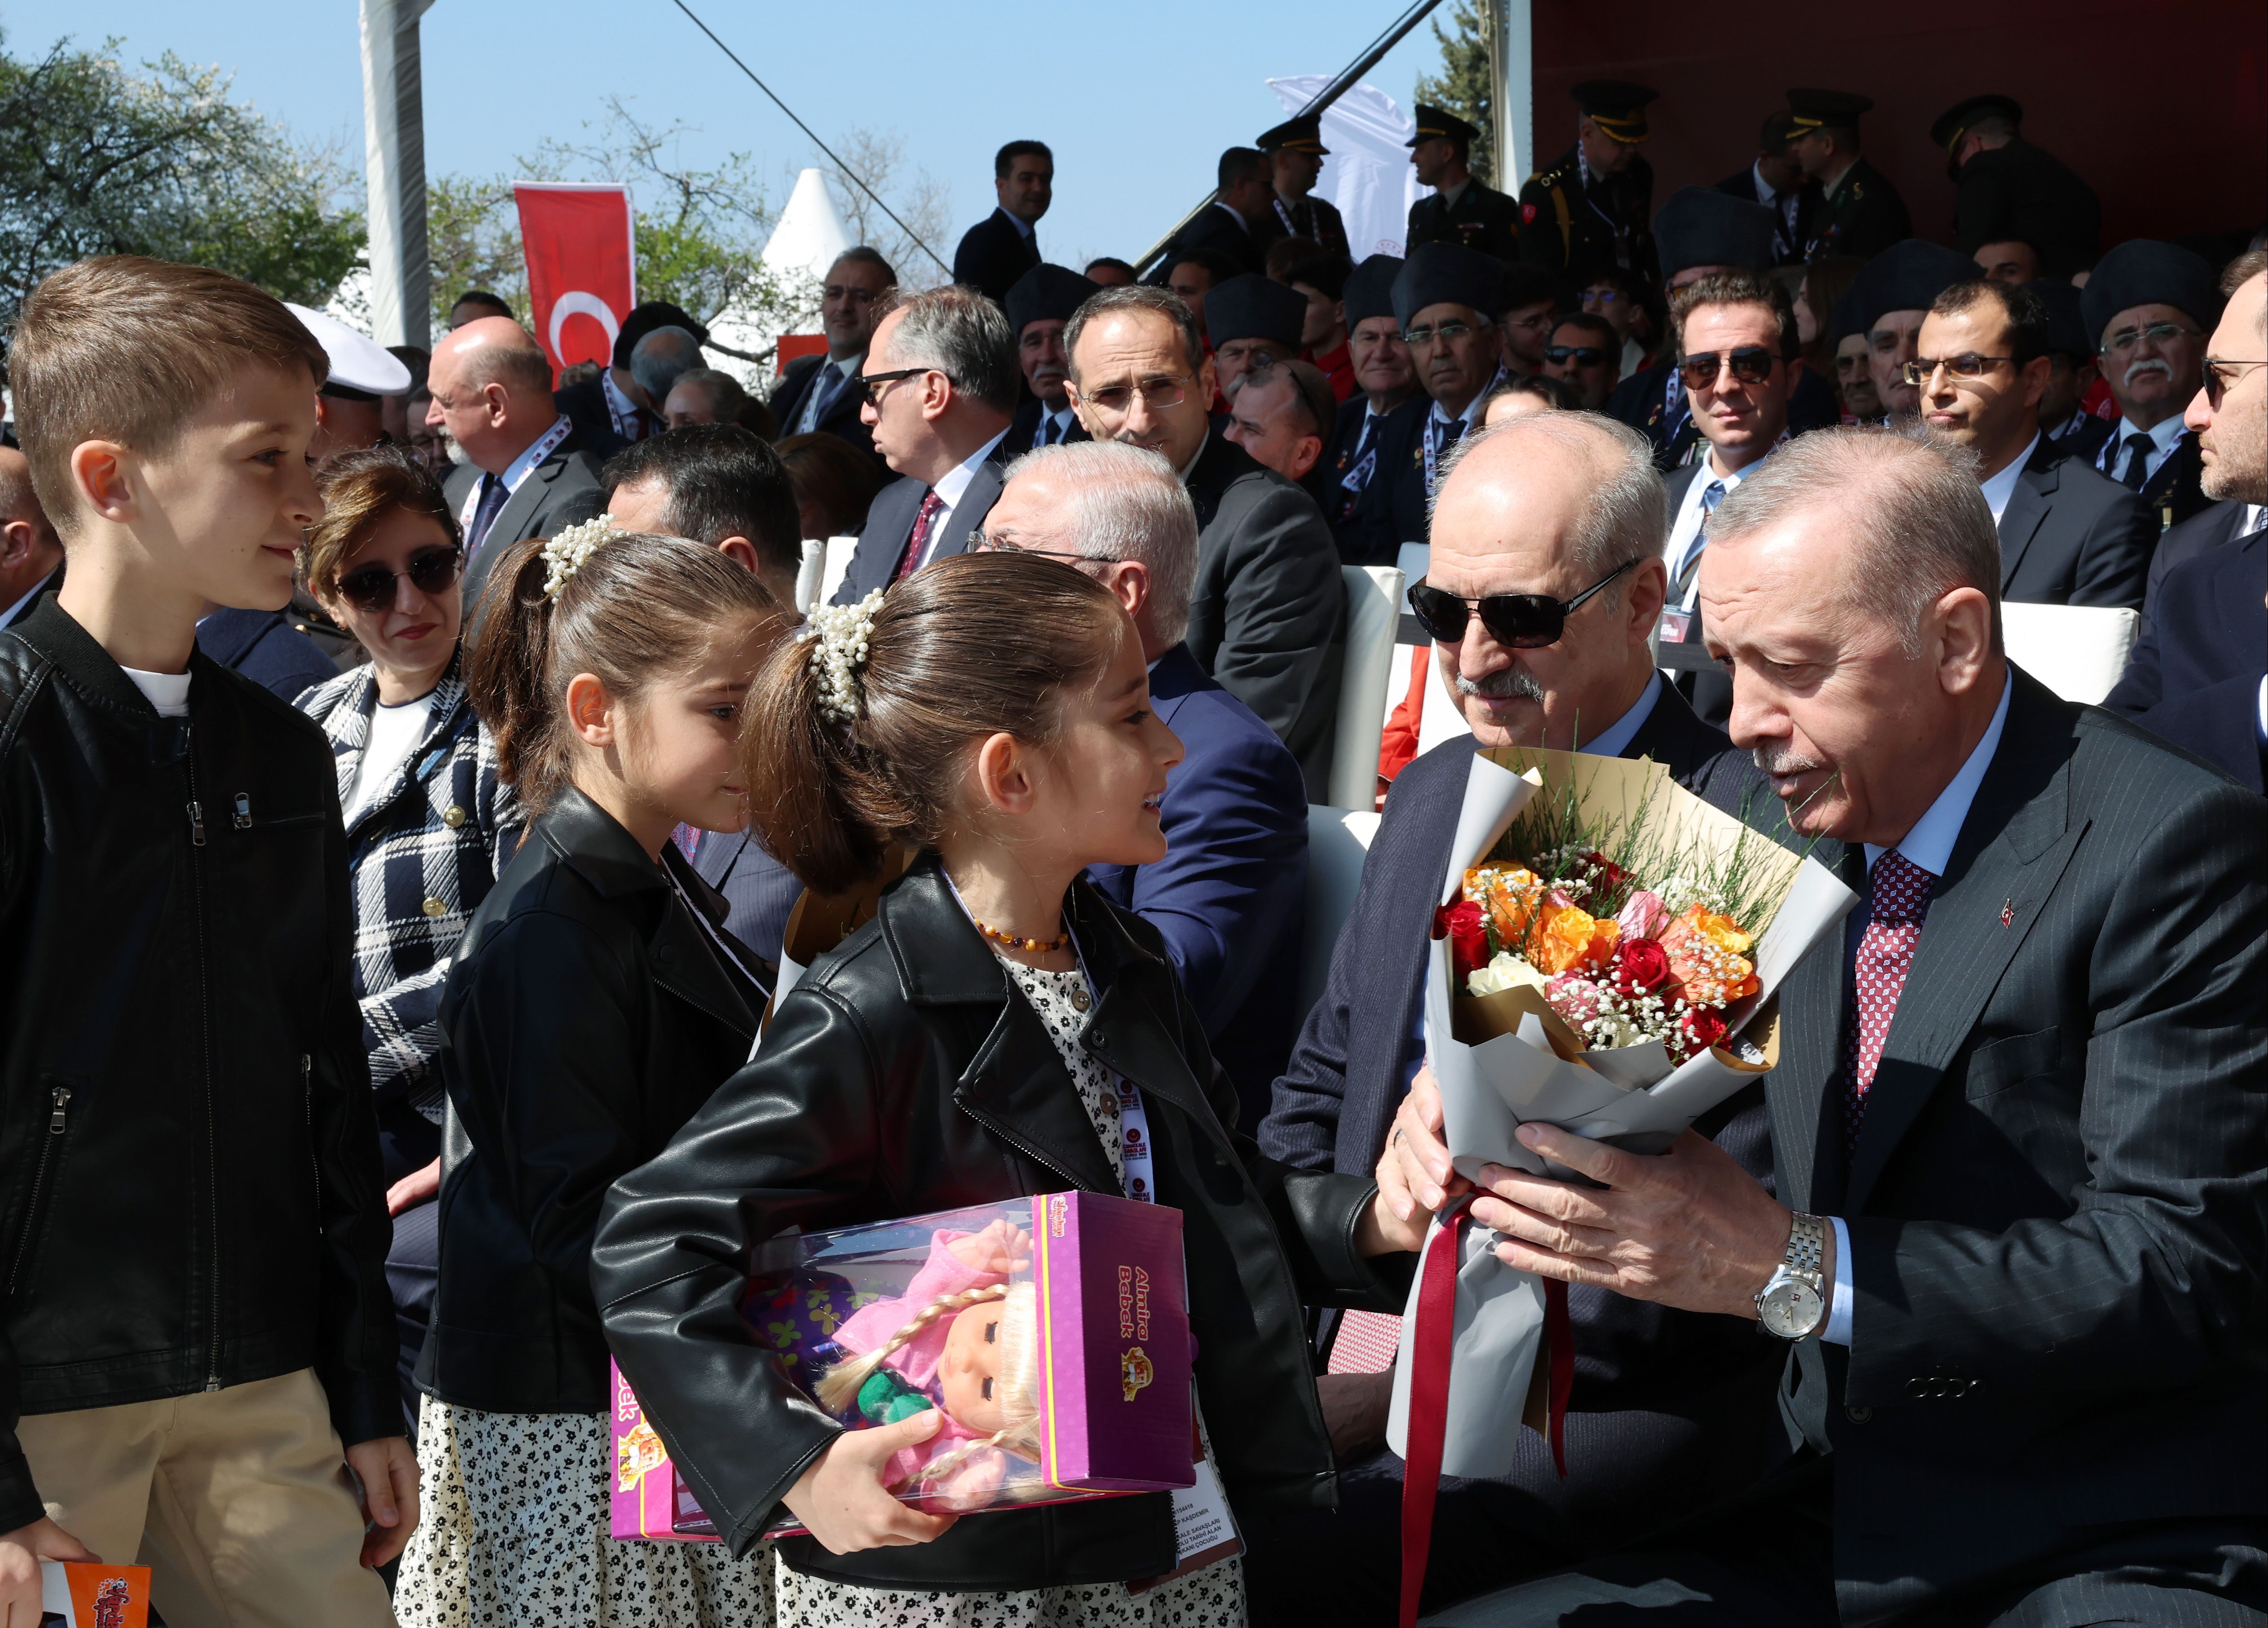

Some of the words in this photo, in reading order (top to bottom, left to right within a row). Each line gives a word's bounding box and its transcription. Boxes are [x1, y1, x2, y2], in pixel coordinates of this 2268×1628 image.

[1119, 1265, 1134, 1338] Bebek
[1136, 1266, 1150, 1341] Almira
[1181, 1509, 1209, 1523] KAŞDEMİR
[1189, 1531, 1207, 1542] TARİHİ
[1207, 1525, 1222, 1535] ALAN
[1191, 1518, 1220, 1534] SAVAŞLARI
[1195, 1535, 1218, 1548] ÇOCUĞU
